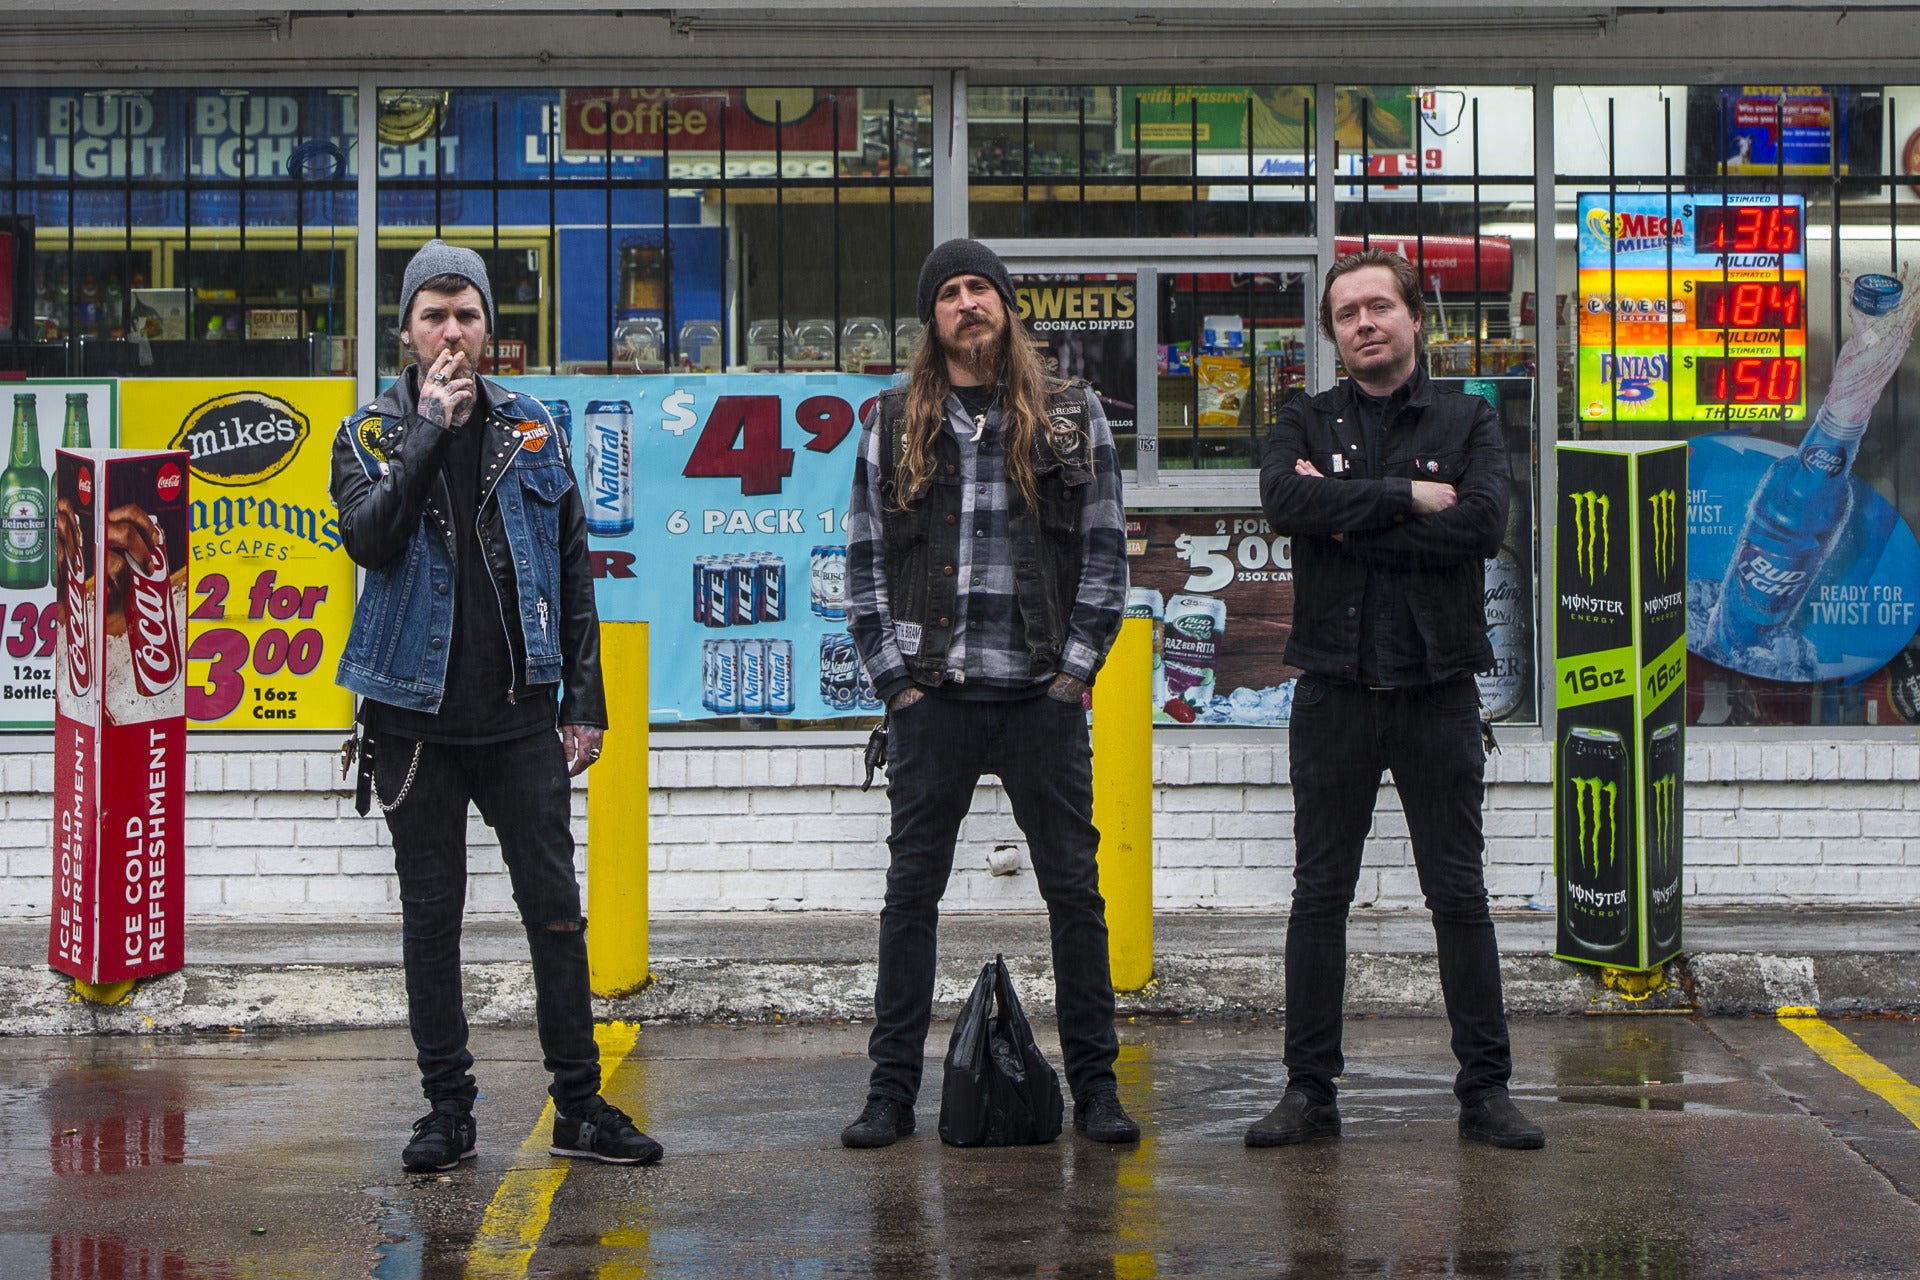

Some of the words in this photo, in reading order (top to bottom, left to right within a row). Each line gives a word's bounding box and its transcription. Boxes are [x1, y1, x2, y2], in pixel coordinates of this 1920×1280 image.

[49, 97, 154, 136] BUD
[196, 96, 299, 135] BUD
[580, 103, 707, 135] Coffee
[36, 136, 165, 178] LIGHT
[1682, 204, 1693, 217] $
[1618, 213, 1684, 238] MEGA
[1716, 208, 1797, 250] 136
[1714, 256, 1781, 268] MILLION
[1683, 280, 1693, 293] $
[1015, 285, 1135, 320] SWEETS
[1716, 283, 1798, 326] 184
[1033, 320, 1086, 332] COGNAC
[1089, 319, 1135, 331] DIPPED
[1715, 331, 1781, 343] MILLION
[1600, 353, 1669, 384] FANTASY
[1683, 355, 1694, 369] $
[1716, 359, 1799, 402] 150
[1704, 407, 1794, 419] THOUSAND
[188, 414, 296, 460] mike's
[620, 427, 631, 478] Light
[1806, 456, 1842, 473] LIGHT
[1814, 449, 1842, 464] BUD
[158, 475, 181, 488] Coca-Cola
[595, 425, 621, 512] Natural
[2, 519, 45, 529] Heineken
[666, 509, 690, 535] 6
[703, 509, 804, 535] PACK
[1215, 519, 1227, 535] 2
[1233, 519, 1271, 535] FOR
[1701, 526, 1733, 535] BOTTLE
[192, 540, 288, 561] ESCAPES
[1238, 571, 1267, 582] 25OZ
[1738, 560, 1803, 597] LIGHT
[1750, 555, 1807, 582] BUD
[189, 573, 229, 620] 2
[248, 570, 328, 620] for
[711, 573, 725, 625] ICE
[739, 570, 752, 623] ICE
[766, 568, 779, 618] ICE
[1561, 593, 1625, 616] MONSTER
[1644, 591, 1683, 615] MONSTER
[1820, 585, 1868, 601] READY
[1873, 585, 1903, 601] FOR
[1177, 621, 1213, 631] LIGHT
[1184, 616, 1212, 626] BUD
[1570, 613, 1615, 625] ENERGY
[1809, 602, 1871, 626] TWIST
[1877, 602, 1915, 625] OFF
[13, 665, 51, 680] 12oz
[718, 652, 732, 703] Natural
[744, 651, 759, 702] Natural
[771, 651, 785, 702] Natural
[1564, 665, 1626, 695] 16oz
[1647, 658, 1682, 699] 16oz
[253, 687, 297, 701] 16oz
[252, 705, 297, 719] Cans
[60, 809, 71, 898] COLD
[71, 728, 85, 966] REFRESHMENT
[149, 728, 167, 962] REFRESHMENT
[125, 816, 144, 905] COLD
[1568, 880, 1627, 908] MONSTER
[1573, 902, 1621, 917] ENERGY
[59, 906, 70, 959] ICE
[125, 913, 143, 966] ICE
